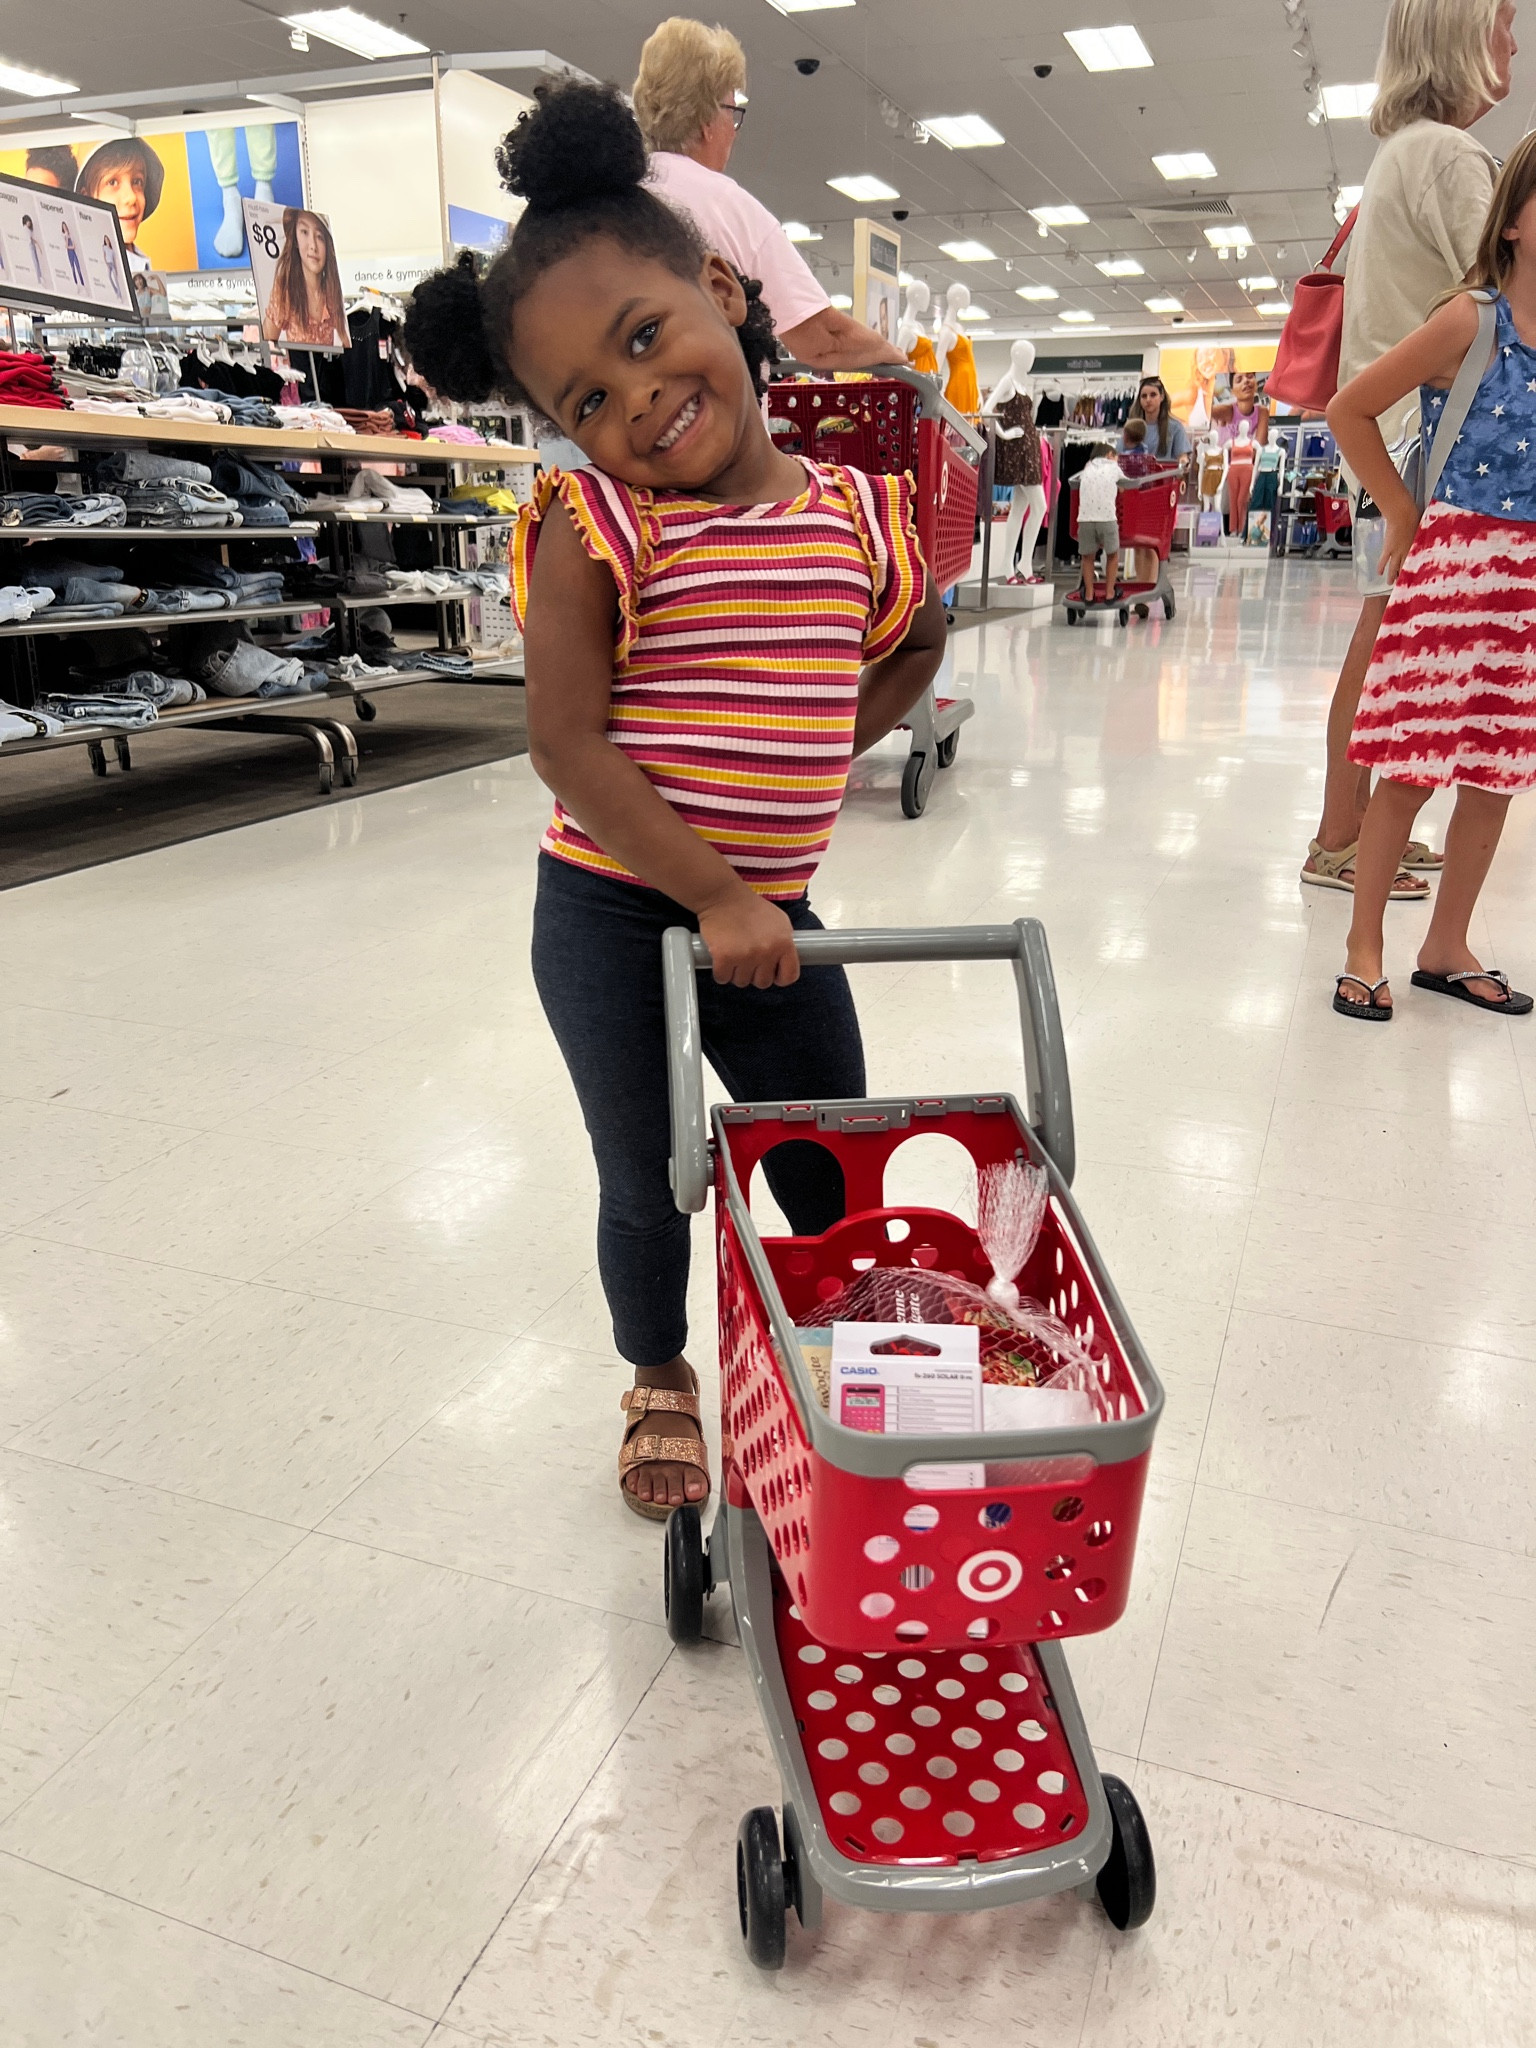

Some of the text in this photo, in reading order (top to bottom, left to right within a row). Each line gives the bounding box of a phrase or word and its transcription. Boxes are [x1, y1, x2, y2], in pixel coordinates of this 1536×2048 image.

[40, 201, 64, 214] tapered
[252, 222, 280, 259] $8
[354, 268, 434, 281] dance & gymnas
[187, 277, 255, 289] dance & gymna
[895, 1289, 907, 1322] enne
[908, 1293, 924, 1323] gate
[840, 1366, 877, 1375] CASIO
